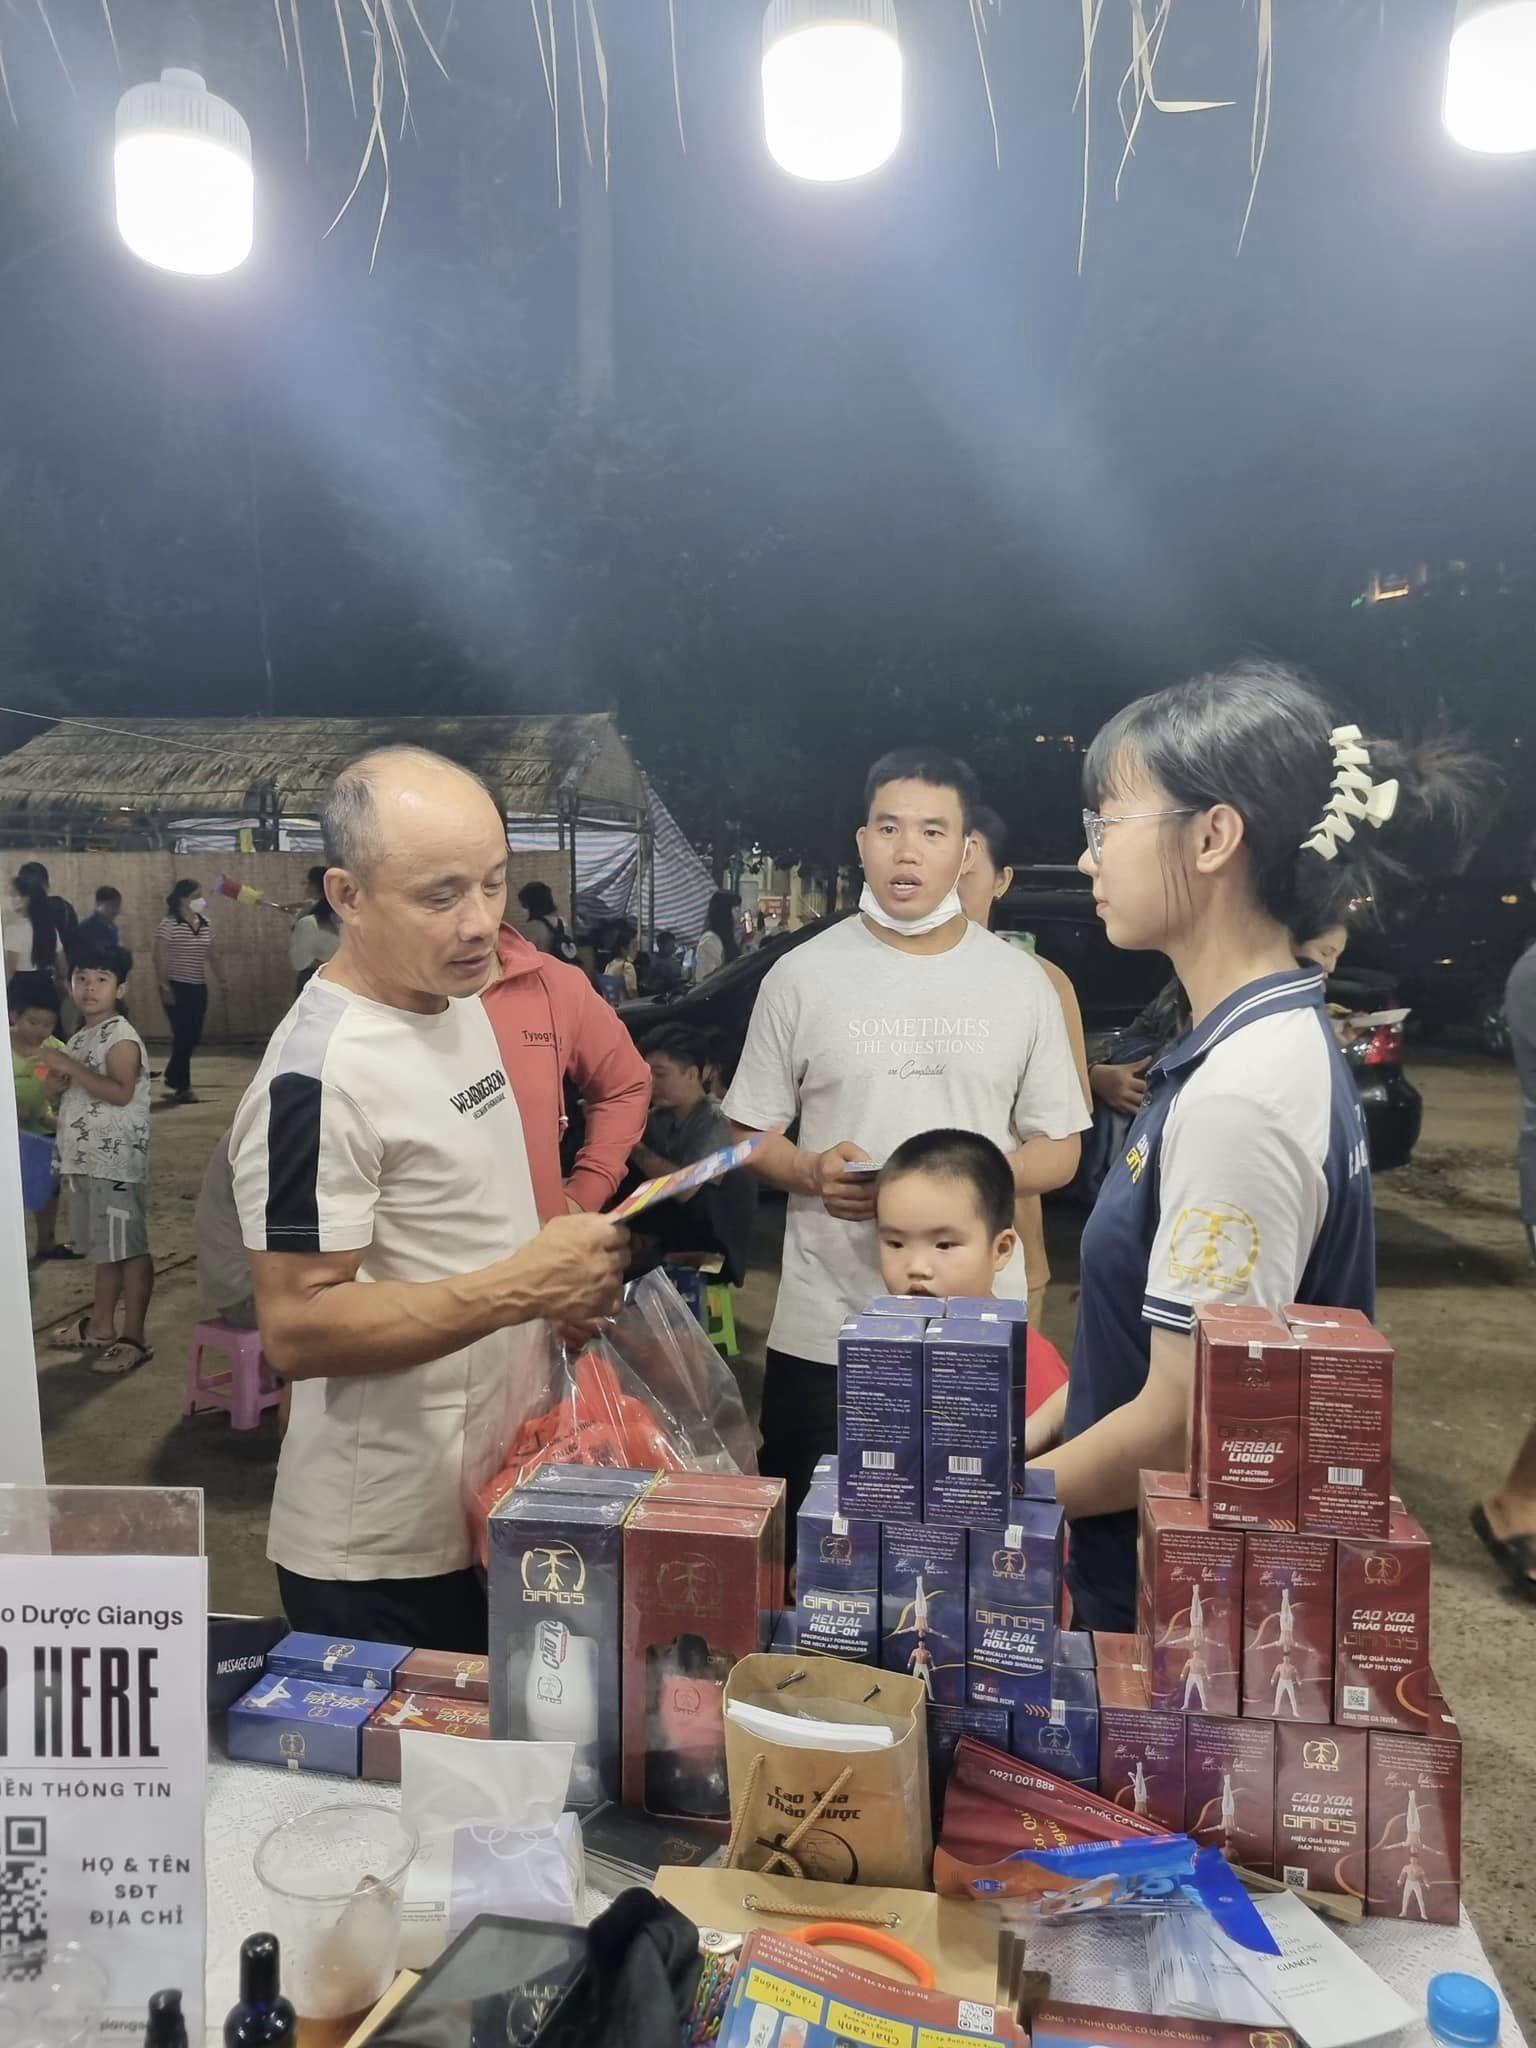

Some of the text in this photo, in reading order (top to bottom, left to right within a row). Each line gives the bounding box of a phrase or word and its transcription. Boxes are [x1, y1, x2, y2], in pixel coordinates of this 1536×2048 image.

[849, 1017, 990, 1038] SOMETIMES
[855, 1039, 985, 1056] THE QUESTIONS
[1221, 1441, 1284, 1454] HERBAL
[1228, 1452, 1274, 1464] LIQUID
[523, 1589, 585, 1605] GIANG'S
[802, 1595, 870, 1615] GIANG'S
[22, 1605, 91, 1629] Dược
[97, 1605, 183, 1630] Giangs
[810, 1613, 863, 1628] HELBAL
[976, 1609, 1045, 1632] GIANG'S
[1352, 1609, 1416, 1623] CAO XOA
[809, 1623, 860, 1637] ROLL-ON
[983, 1628, 1038, 1644] HELBAL
[982, 1638, 1035, 1654] ROLL-ON
[217, 1654, 264, 1674] MASSAGE GUN
[34, 1646, 160, 1757] HERE
[42, 1780, 125, 1797] THÔNG
[134, 1782, 171, 1797] TIN
[1014, 1775, 1034, 1787] 001
[775, 1786, 804, 1803] Cao
[1291, 1792, 1353, 1807] CAO XOA
[767, 1793, 806, 1818] Thảo
[1282, 1814, 1357, 1835] GIANG'S
[82, 1854, 190, 1876] HỌ & TÊN
[115, 1884, 158, 1899] SĐT
[89, 1905, 183, 1928] ĐỊA CHỈ
[774, 1995, 792, 2008] Gel
[1039, 2013, 1065, 2025] CÔNG
[1079, 2018, 1105, 2029] TNHH
[1106, 2021, 1133, 2033] QUỐC
[1149, 2027, 1177, 2040] QUỐC
